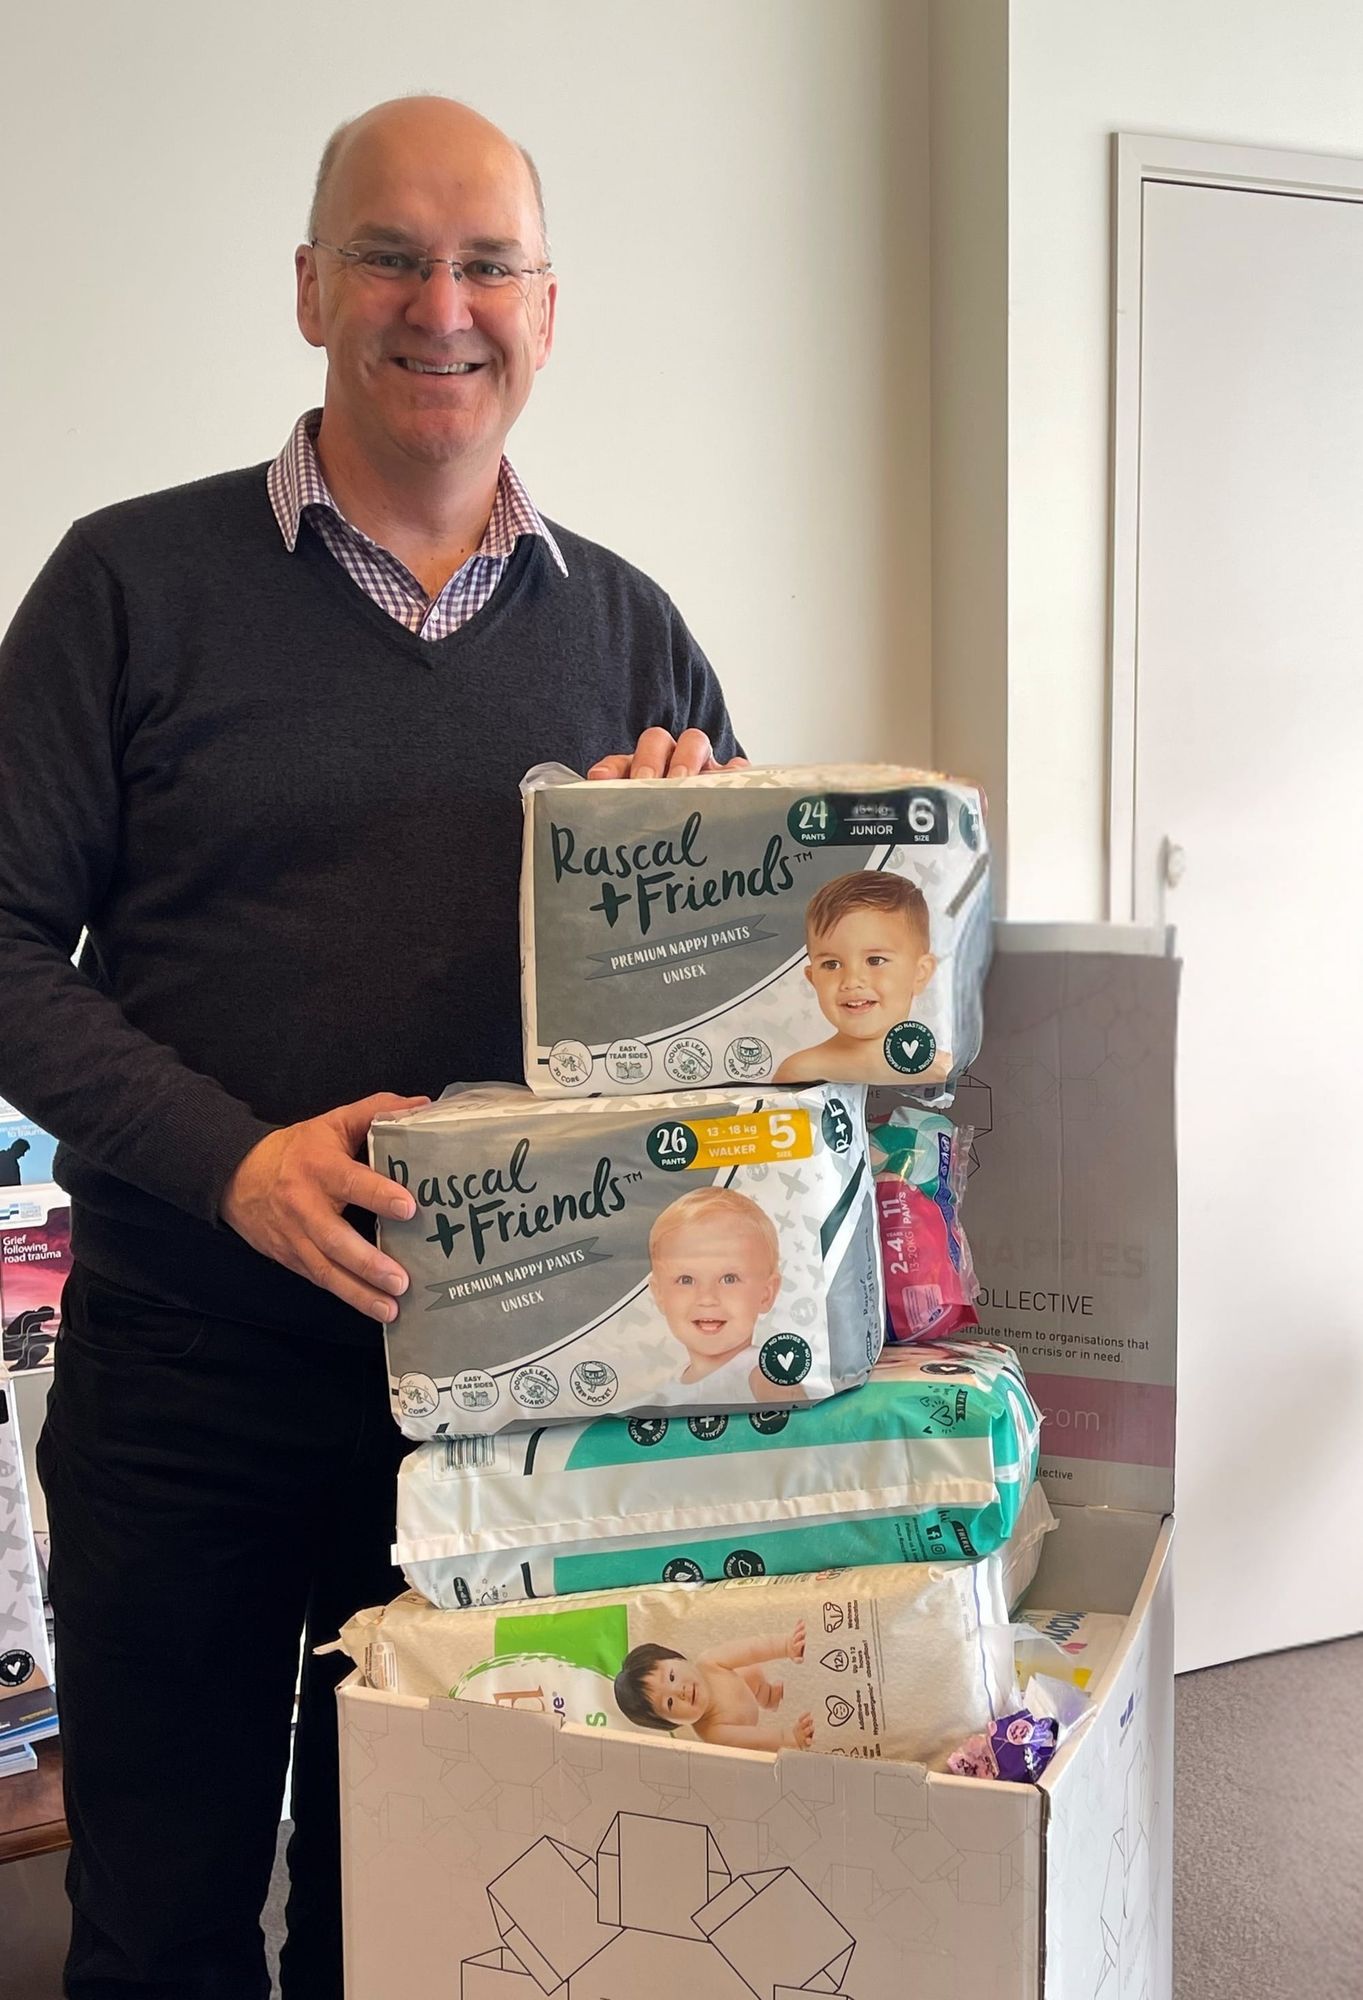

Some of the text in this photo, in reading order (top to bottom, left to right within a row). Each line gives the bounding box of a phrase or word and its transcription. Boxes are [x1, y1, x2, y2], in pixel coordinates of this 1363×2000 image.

[798, 800, 829, 829] 24
[907, 797, 935, 833] 6
[801, 833, 826, 841] PANTS
[850, 824, 894, 835] JUNIOR
[914, 834, 930, 842] SIZE
[550, 811, 708, 884] Rascal
[610, 926, 751, 970] PREMIUM NAPPY PANTS
[662, 963, 707, 985] UNISEX
[628, 1052, 648, 1060] SIDES
[667, 1041, 707, 1065] DOUBLE LEAK
[672, 1067, 697, 1081] GUARD
[728, 1058, 767, 1079] DEEP POCKET
[560, 1074, 581, 1083] CORE
[706, 1127, 719, 1136] 13
[728, 1126, 741, 1135] 18
[744, 1124, 757, 1136] kg
[768, 1114, 796, 1149] 5
[656, 1126, 688, 1155] 26
[708, 1144, 756, 1158] WALKER
[661, 1157, 687, 1166] PANTS
[882, 1199, 901, 1218] 11
[899, 1191, 912, 1224] PANTS
[2, 1234, 27, 1246] Grief
[3, 1243, 48, 1255] following
[4, 1250, 62, 1264] road trauma
[887, 1238, 909, 1275] 2-4
[448, 1249, 585, 1300] PREMIUM NAPPY PANTS
[501, 1290, 545, 1313] UNISEX
[976, 1287, 1094, 1315] OLLECTIVE
[1003, 1328, 1032, 1340] them
[1036, 1331, 1046, 1341] to
[1049, 1332, 1124, 1348] organisations
[1127, 1339, 1150, 1350] that
[1019, 1346, 1124, 1363] in crisis or in need.
[474, 1381, 494, 1389] SIDES
[513, 1368, 552, 1391] DOUBLE LEAK
[519, 1394, 545, 1407] GUARD
[574, 1381, 613, 1403] DEEP POCKET
[408, 1406, 429, 1415] CORE
[850, 1646, 856, 1655] 12
